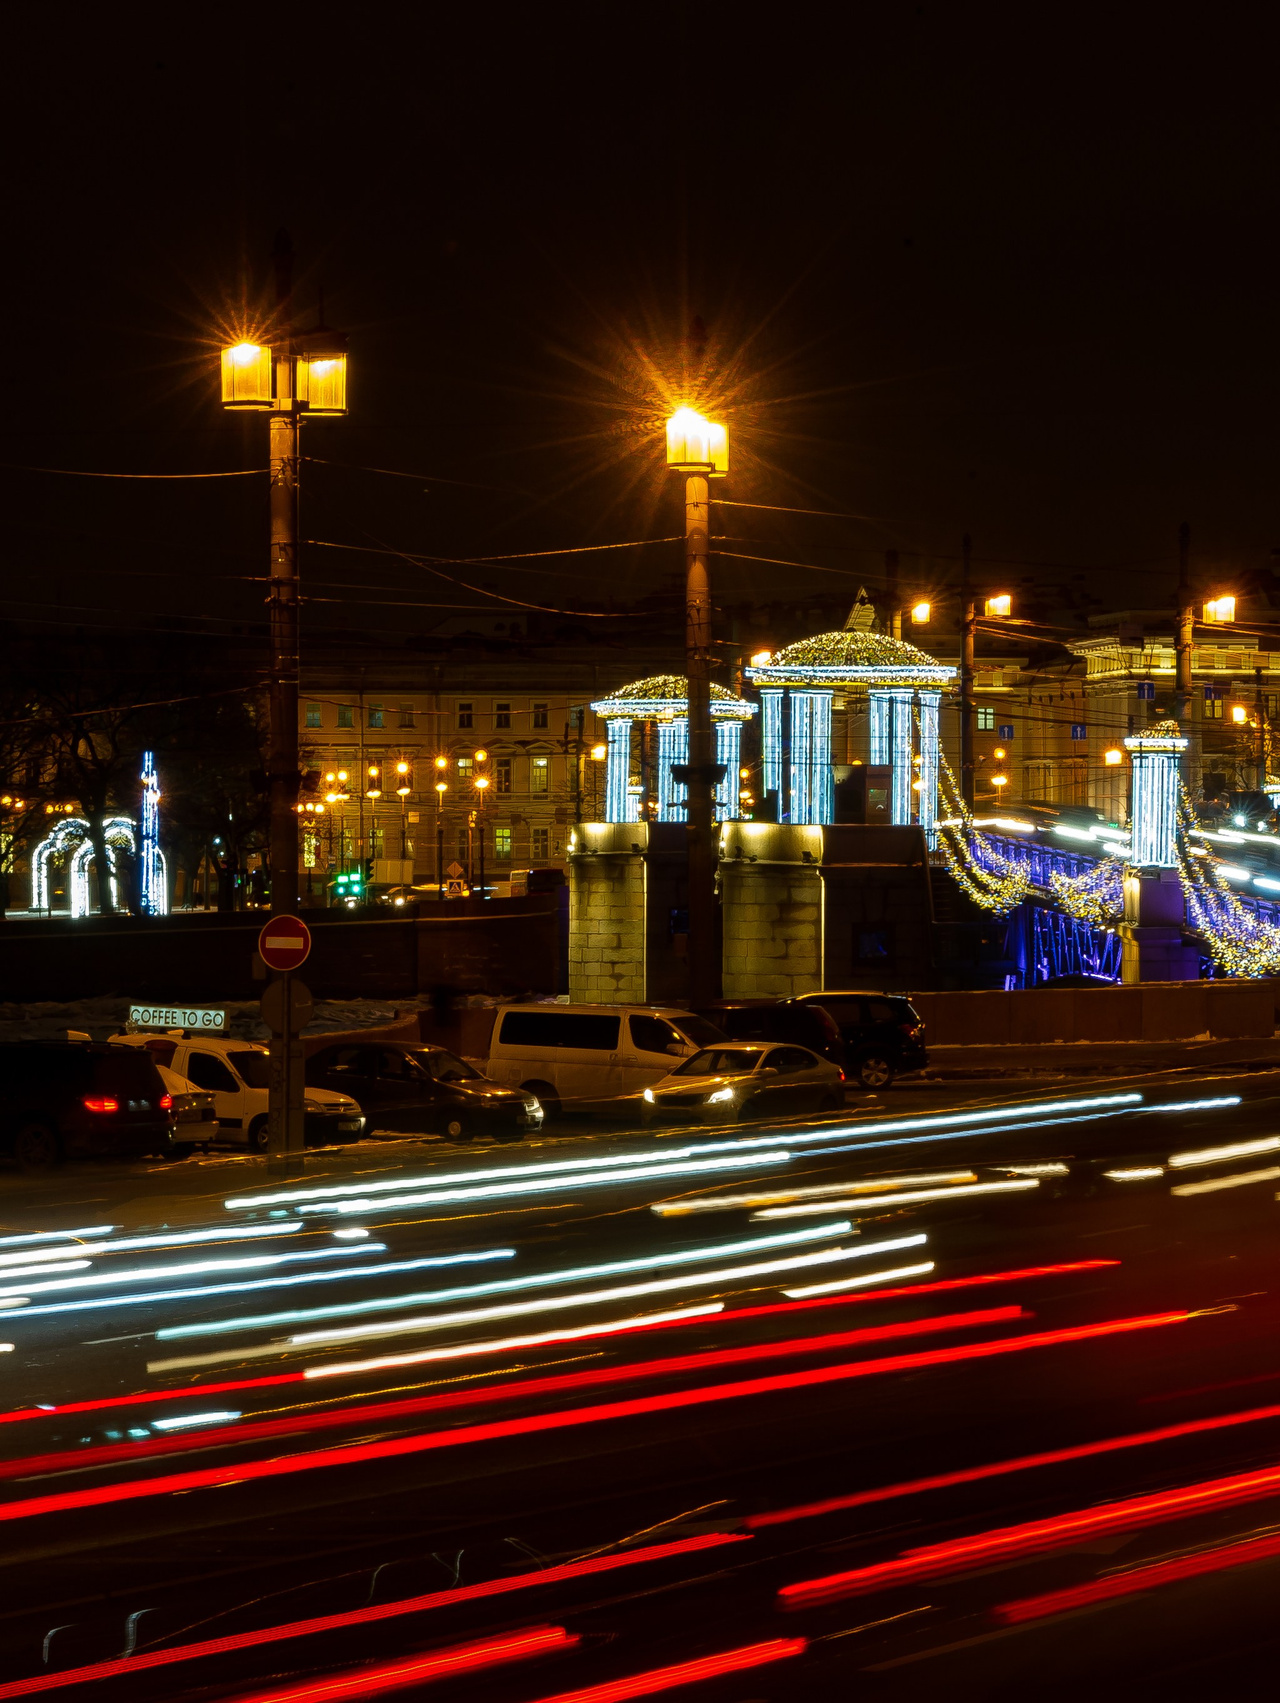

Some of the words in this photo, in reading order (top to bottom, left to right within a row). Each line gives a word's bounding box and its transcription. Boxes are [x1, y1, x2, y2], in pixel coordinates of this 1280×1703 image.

[130, 1009, 177, 1025] COFFEE
[181, 1011, 197, 1026] TO
[202, 1012, 223, 1027] GO
